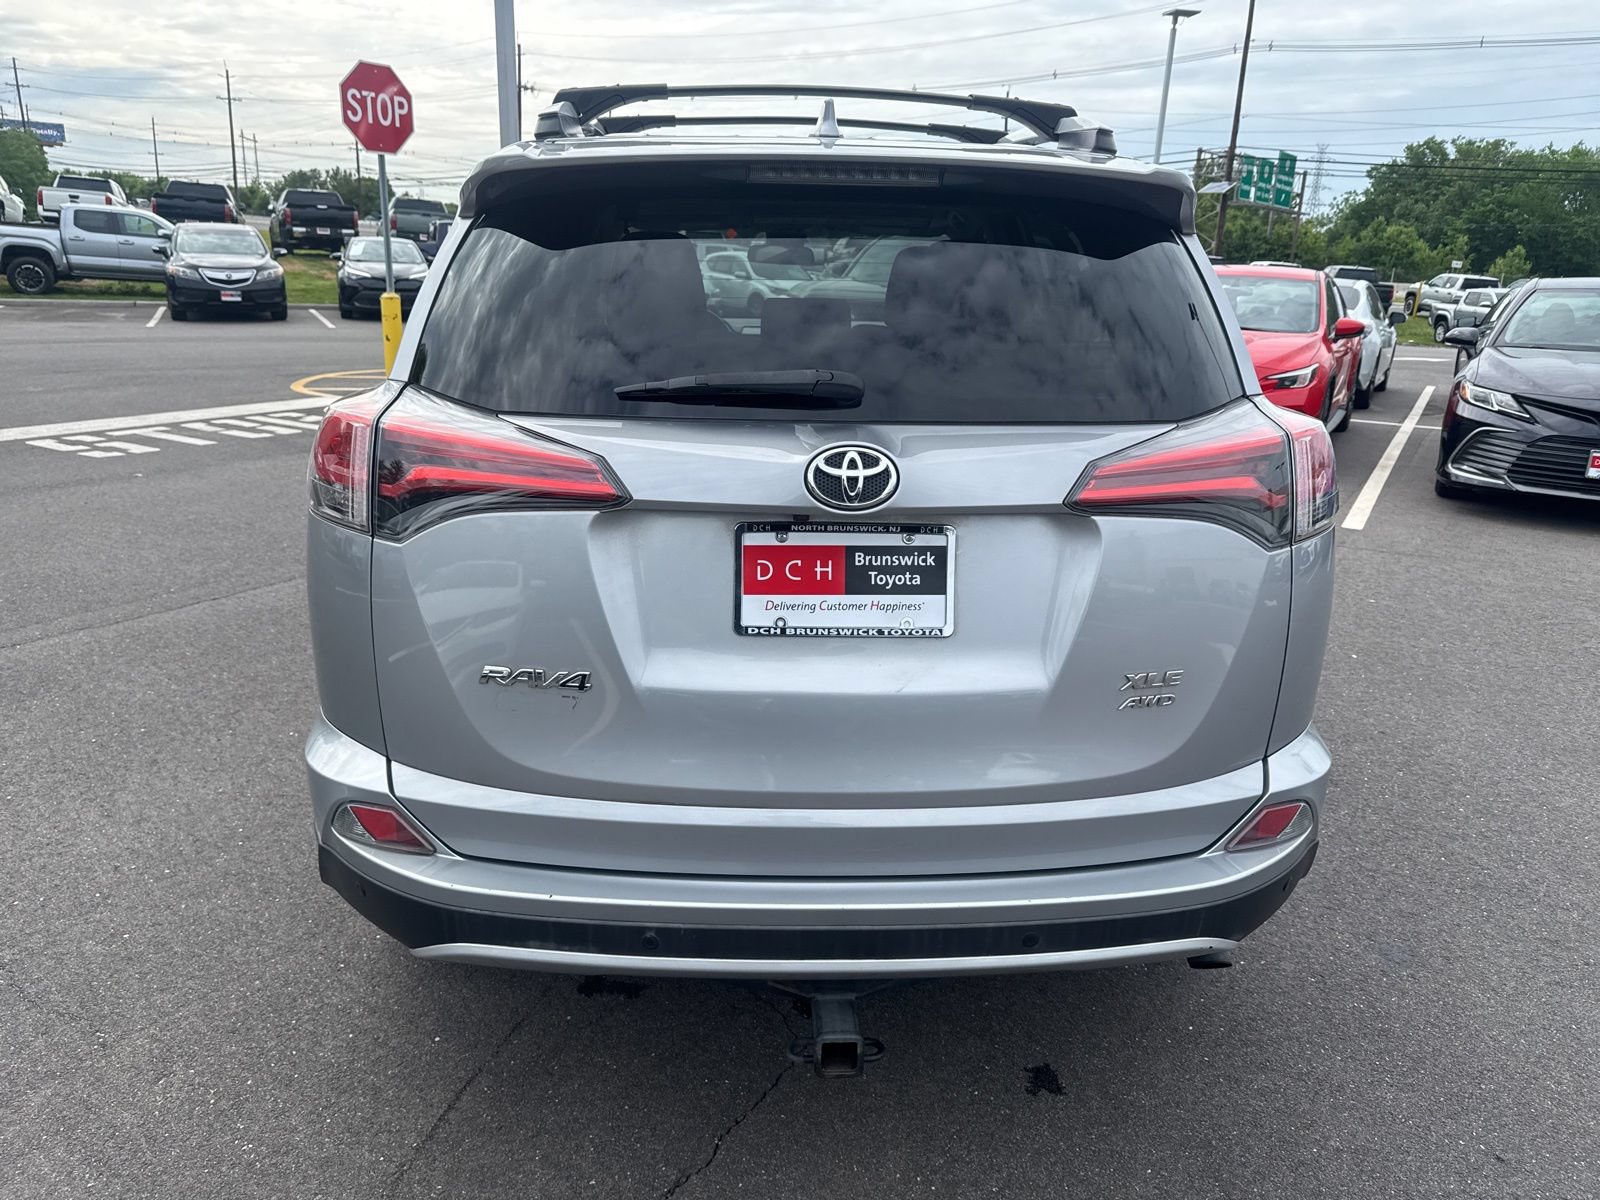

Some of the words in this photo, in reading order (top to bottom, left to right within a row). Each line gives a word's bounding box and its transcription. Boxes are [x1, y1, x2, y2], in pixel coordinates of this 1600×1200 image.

[346, 88, 409, 128] STOP
[854, 551, 936, 566] Brunswick
[756, 559, 832, 581] DCH
[868, 571, 921, 590] Toyota
[765, 600, 817, 614] Delivering
[819, 600, 868, 612] Customer
[747, 627, 781, 635] DCH
[785, 628, 879, 636] BRUNSWICK
[881, 628, 941, 636] TOYOTA
[479, 665, 592, 692] RAV4
[1119, 669, 1184, 691] XLE
[1117, 694, 1176, 711] AWD
